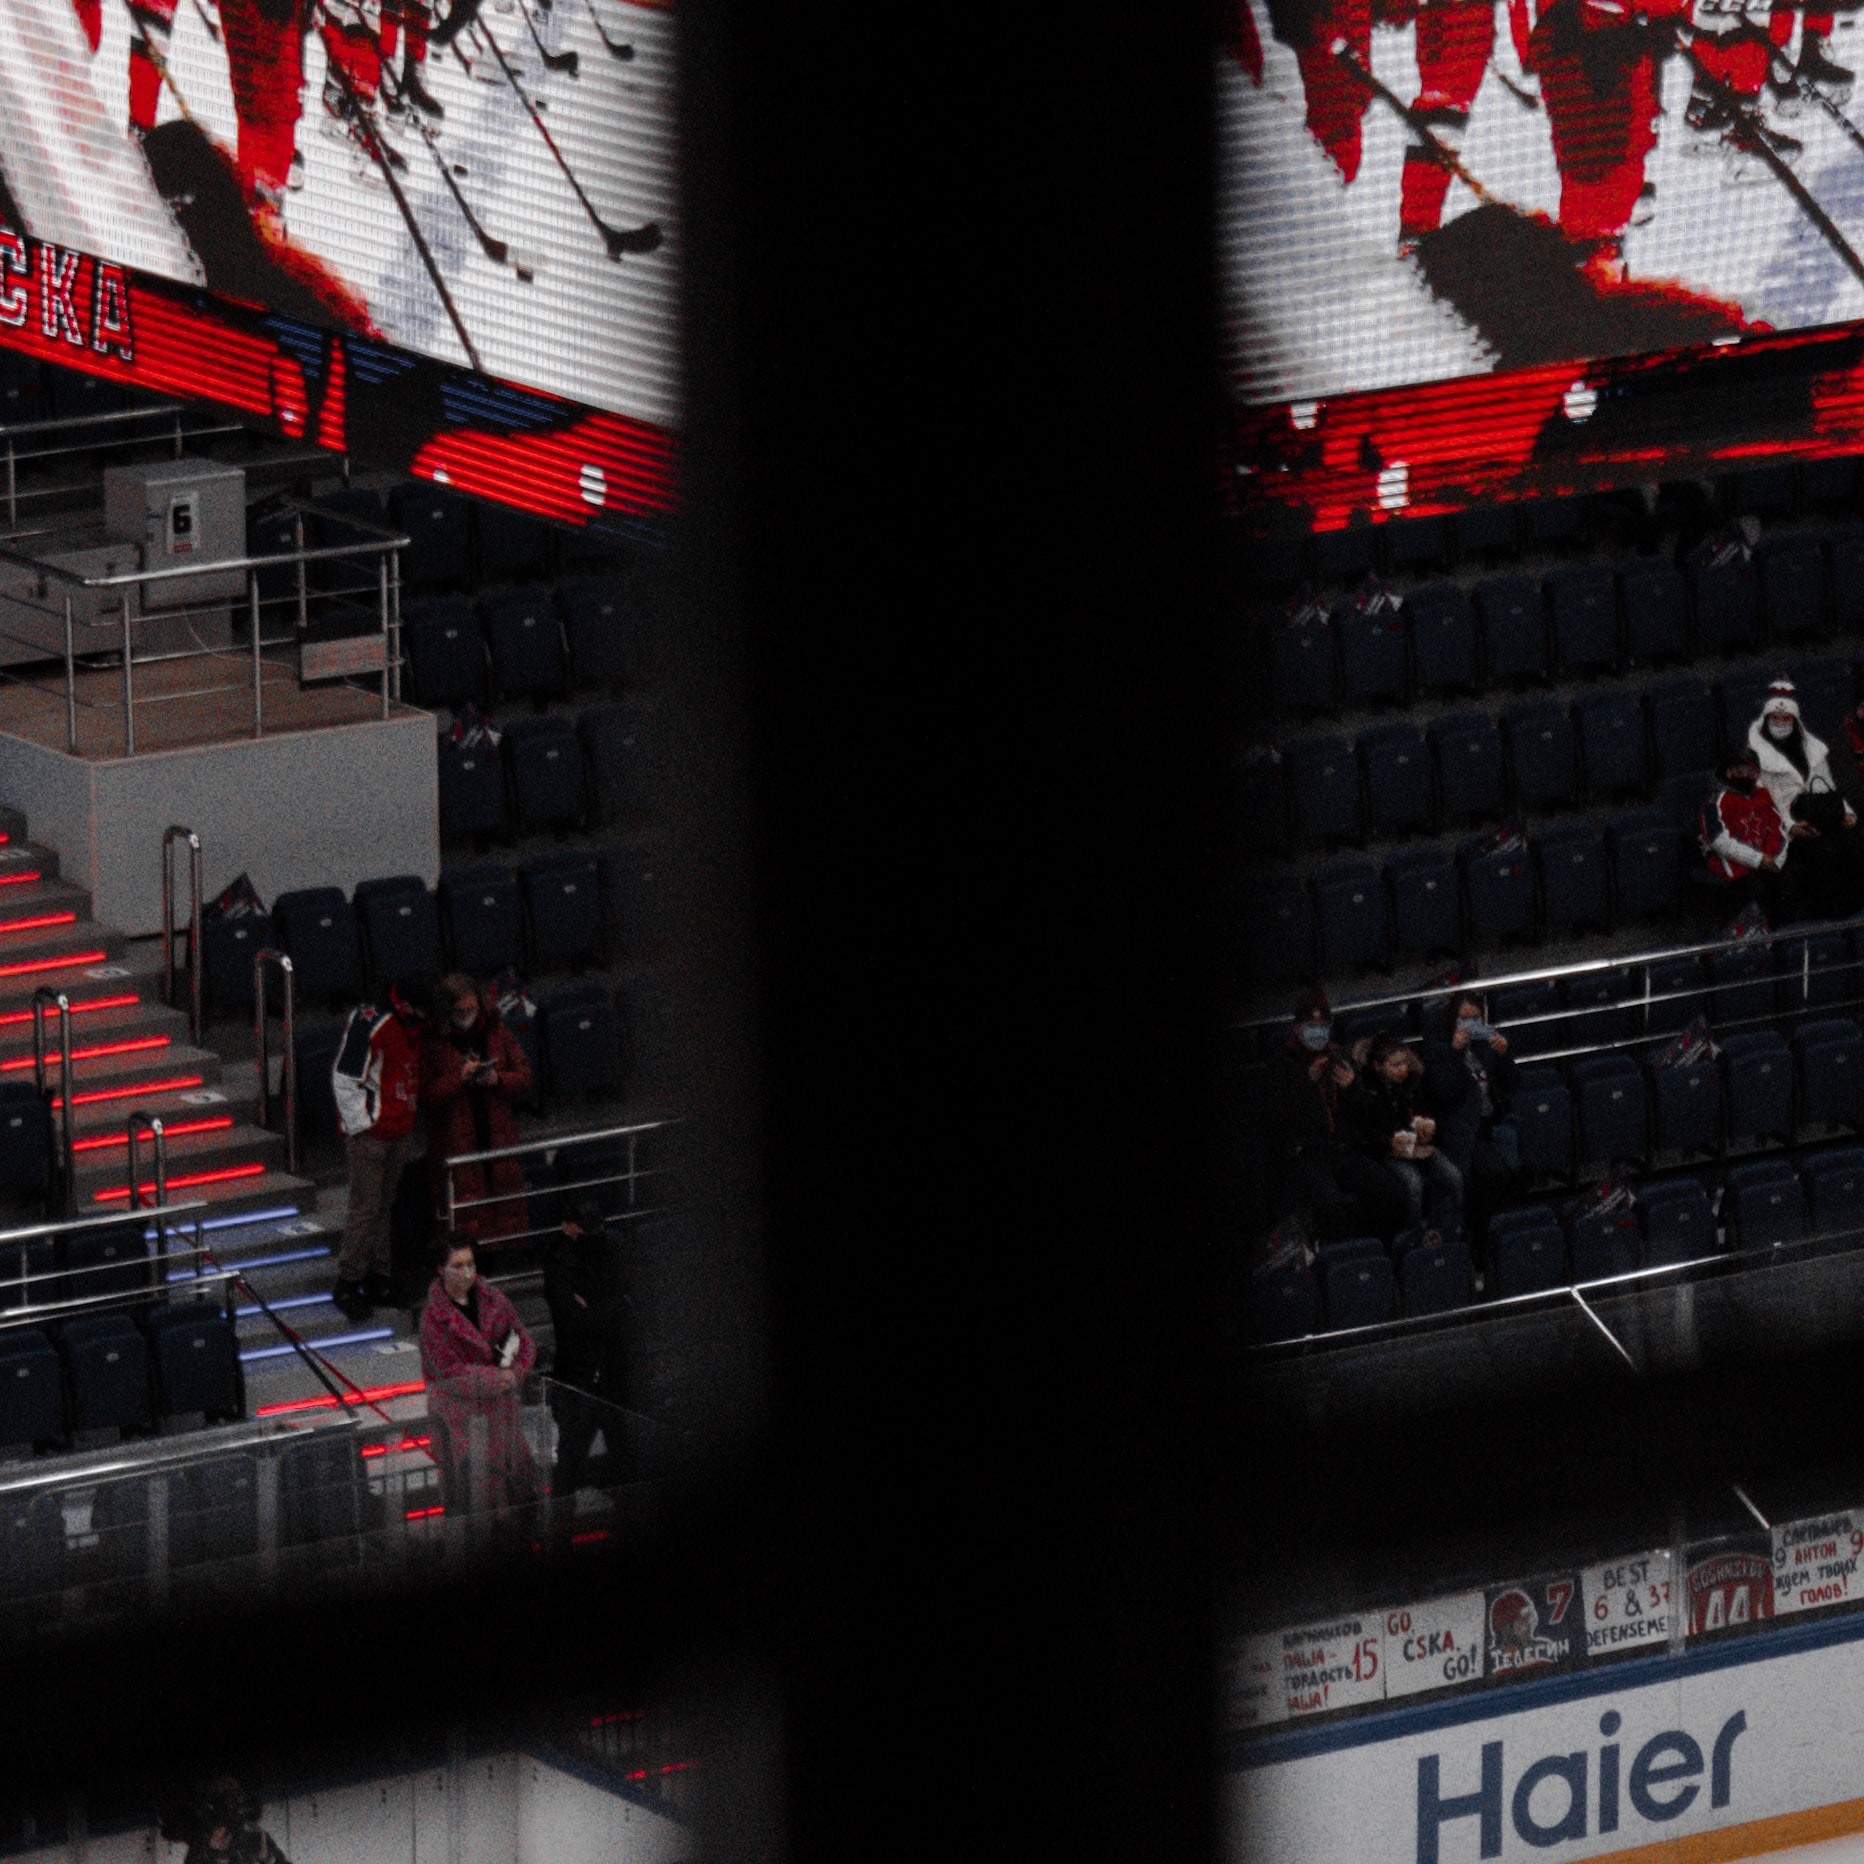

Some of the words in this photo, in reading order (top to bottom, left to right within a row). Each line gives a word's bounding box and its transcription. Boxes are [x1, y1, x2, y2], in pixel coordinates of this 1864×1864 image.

[172, 504, 192, 535] 6
[1794, 1541, 1839, 1566] АНТОН
[1603, 1559, 1651, 1591] BEST
[1547, 1579, 1575, 1626] 7
[1593, 1595, 1610, 1622] 6
[1352, 1638, 1379, 1682] 15
[1442, 1643, 1478, 1681] GO!
